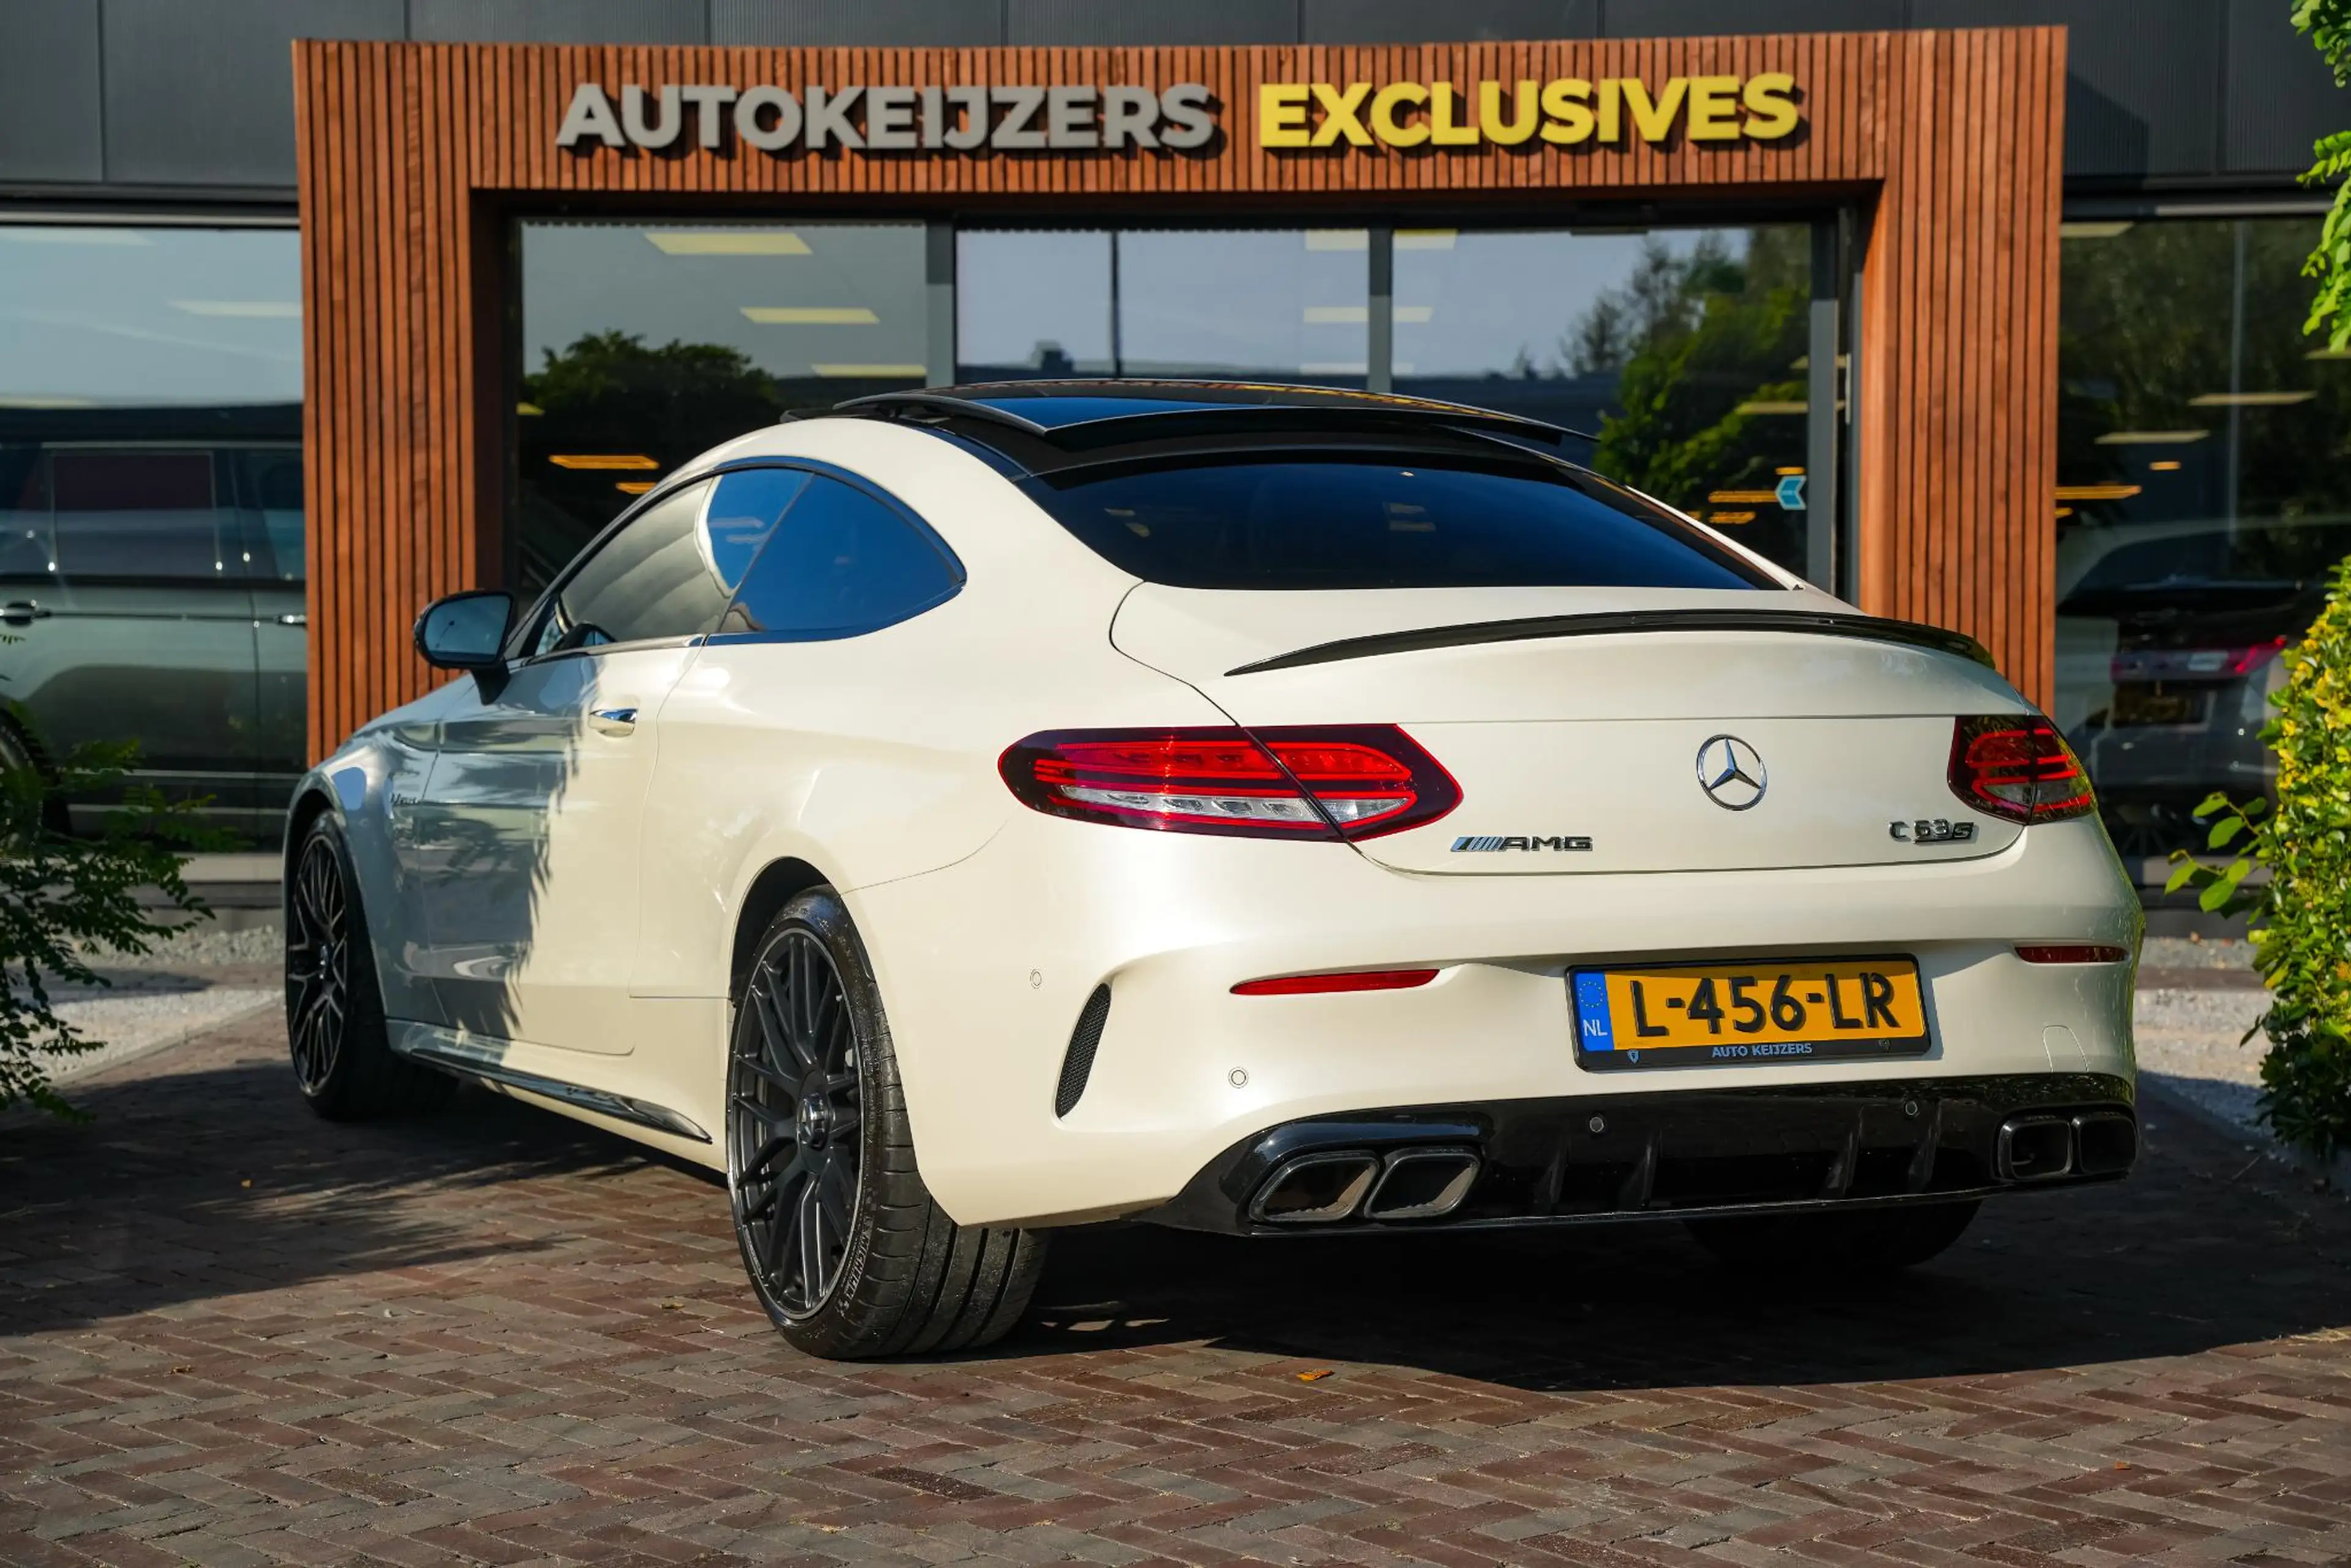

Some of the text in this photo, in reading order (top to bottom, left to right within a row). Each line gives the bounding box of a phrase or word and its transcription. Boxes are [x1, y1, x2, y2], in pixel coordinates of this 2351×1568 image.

[555, 72, 1798, 151] AUTOKEIJZERS EXCLUSIVES
[1629, 972, 1902, 1037] L-456-LR
[1583, 1019, 1608, 1037] NL
[1711, 1043, 1813, 1058] AUTO KEIJZERS
